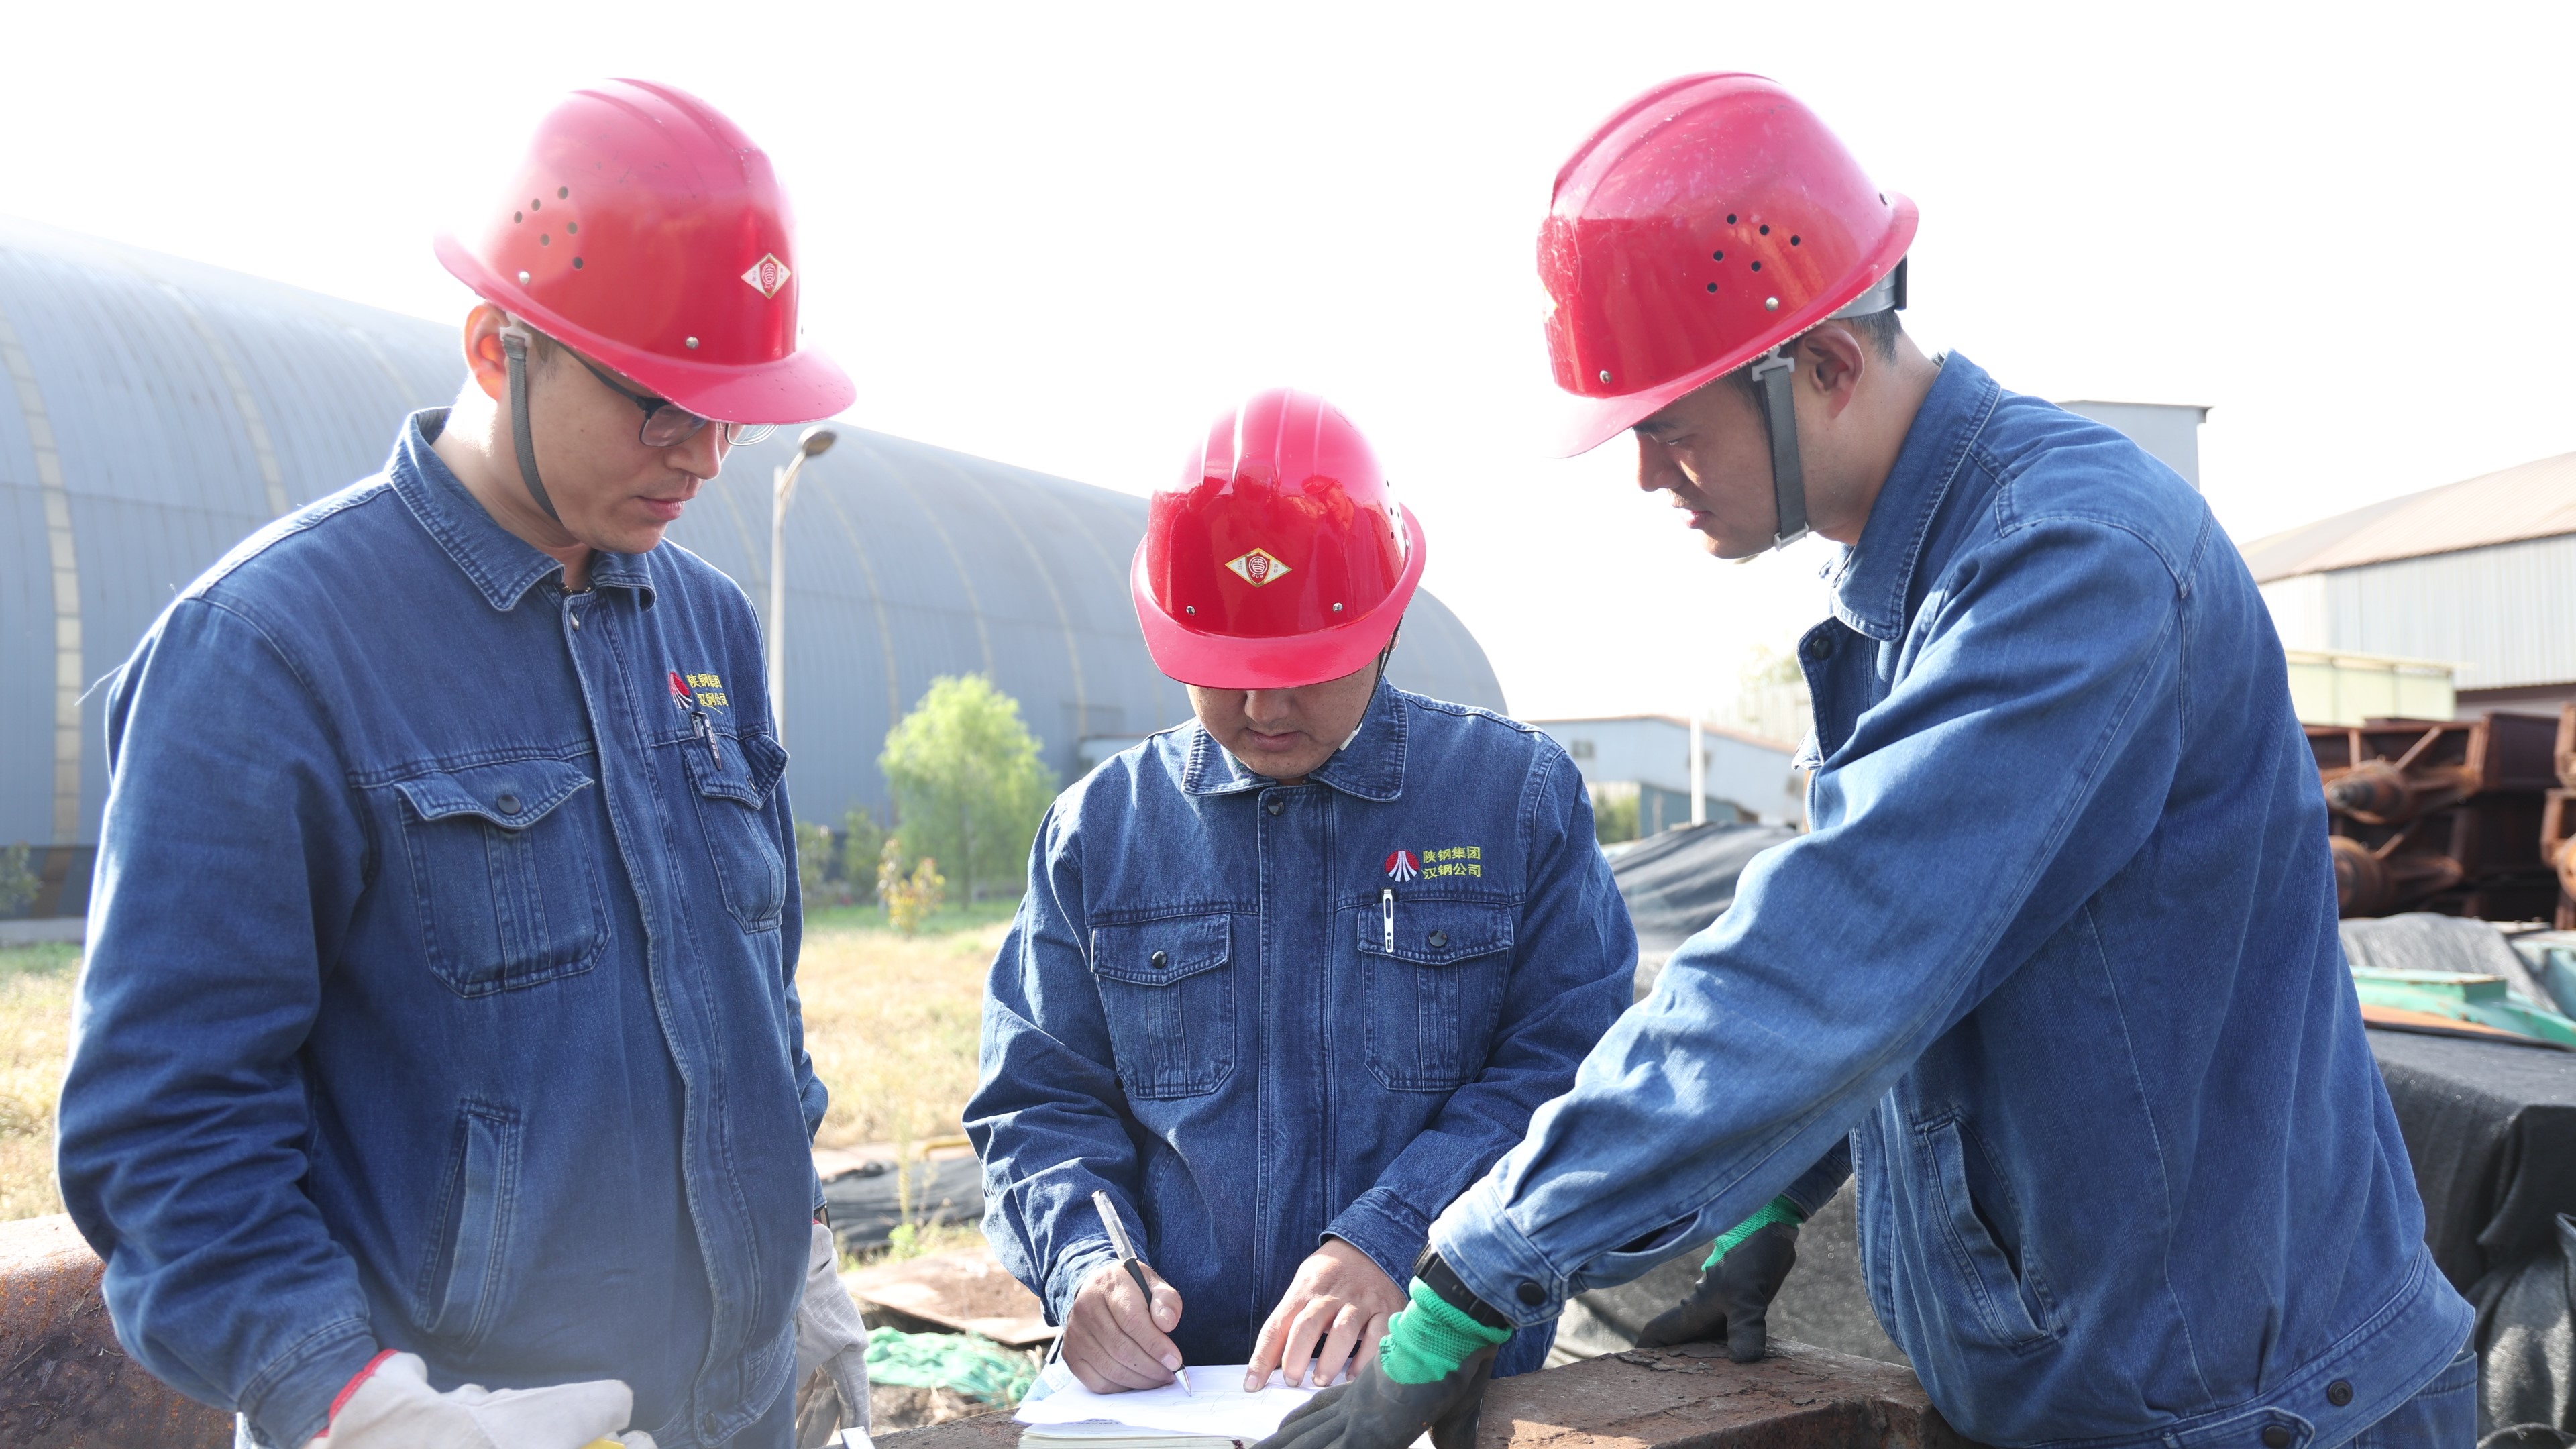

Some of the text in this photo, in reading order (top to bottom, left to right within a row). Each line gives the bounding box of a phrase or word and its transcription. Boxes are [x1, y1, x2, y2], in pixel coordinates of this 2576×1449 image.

[1423, 846, 1481, 863] 陕钢集团
[1421, 863, 1481, 879] 汉钢公司
